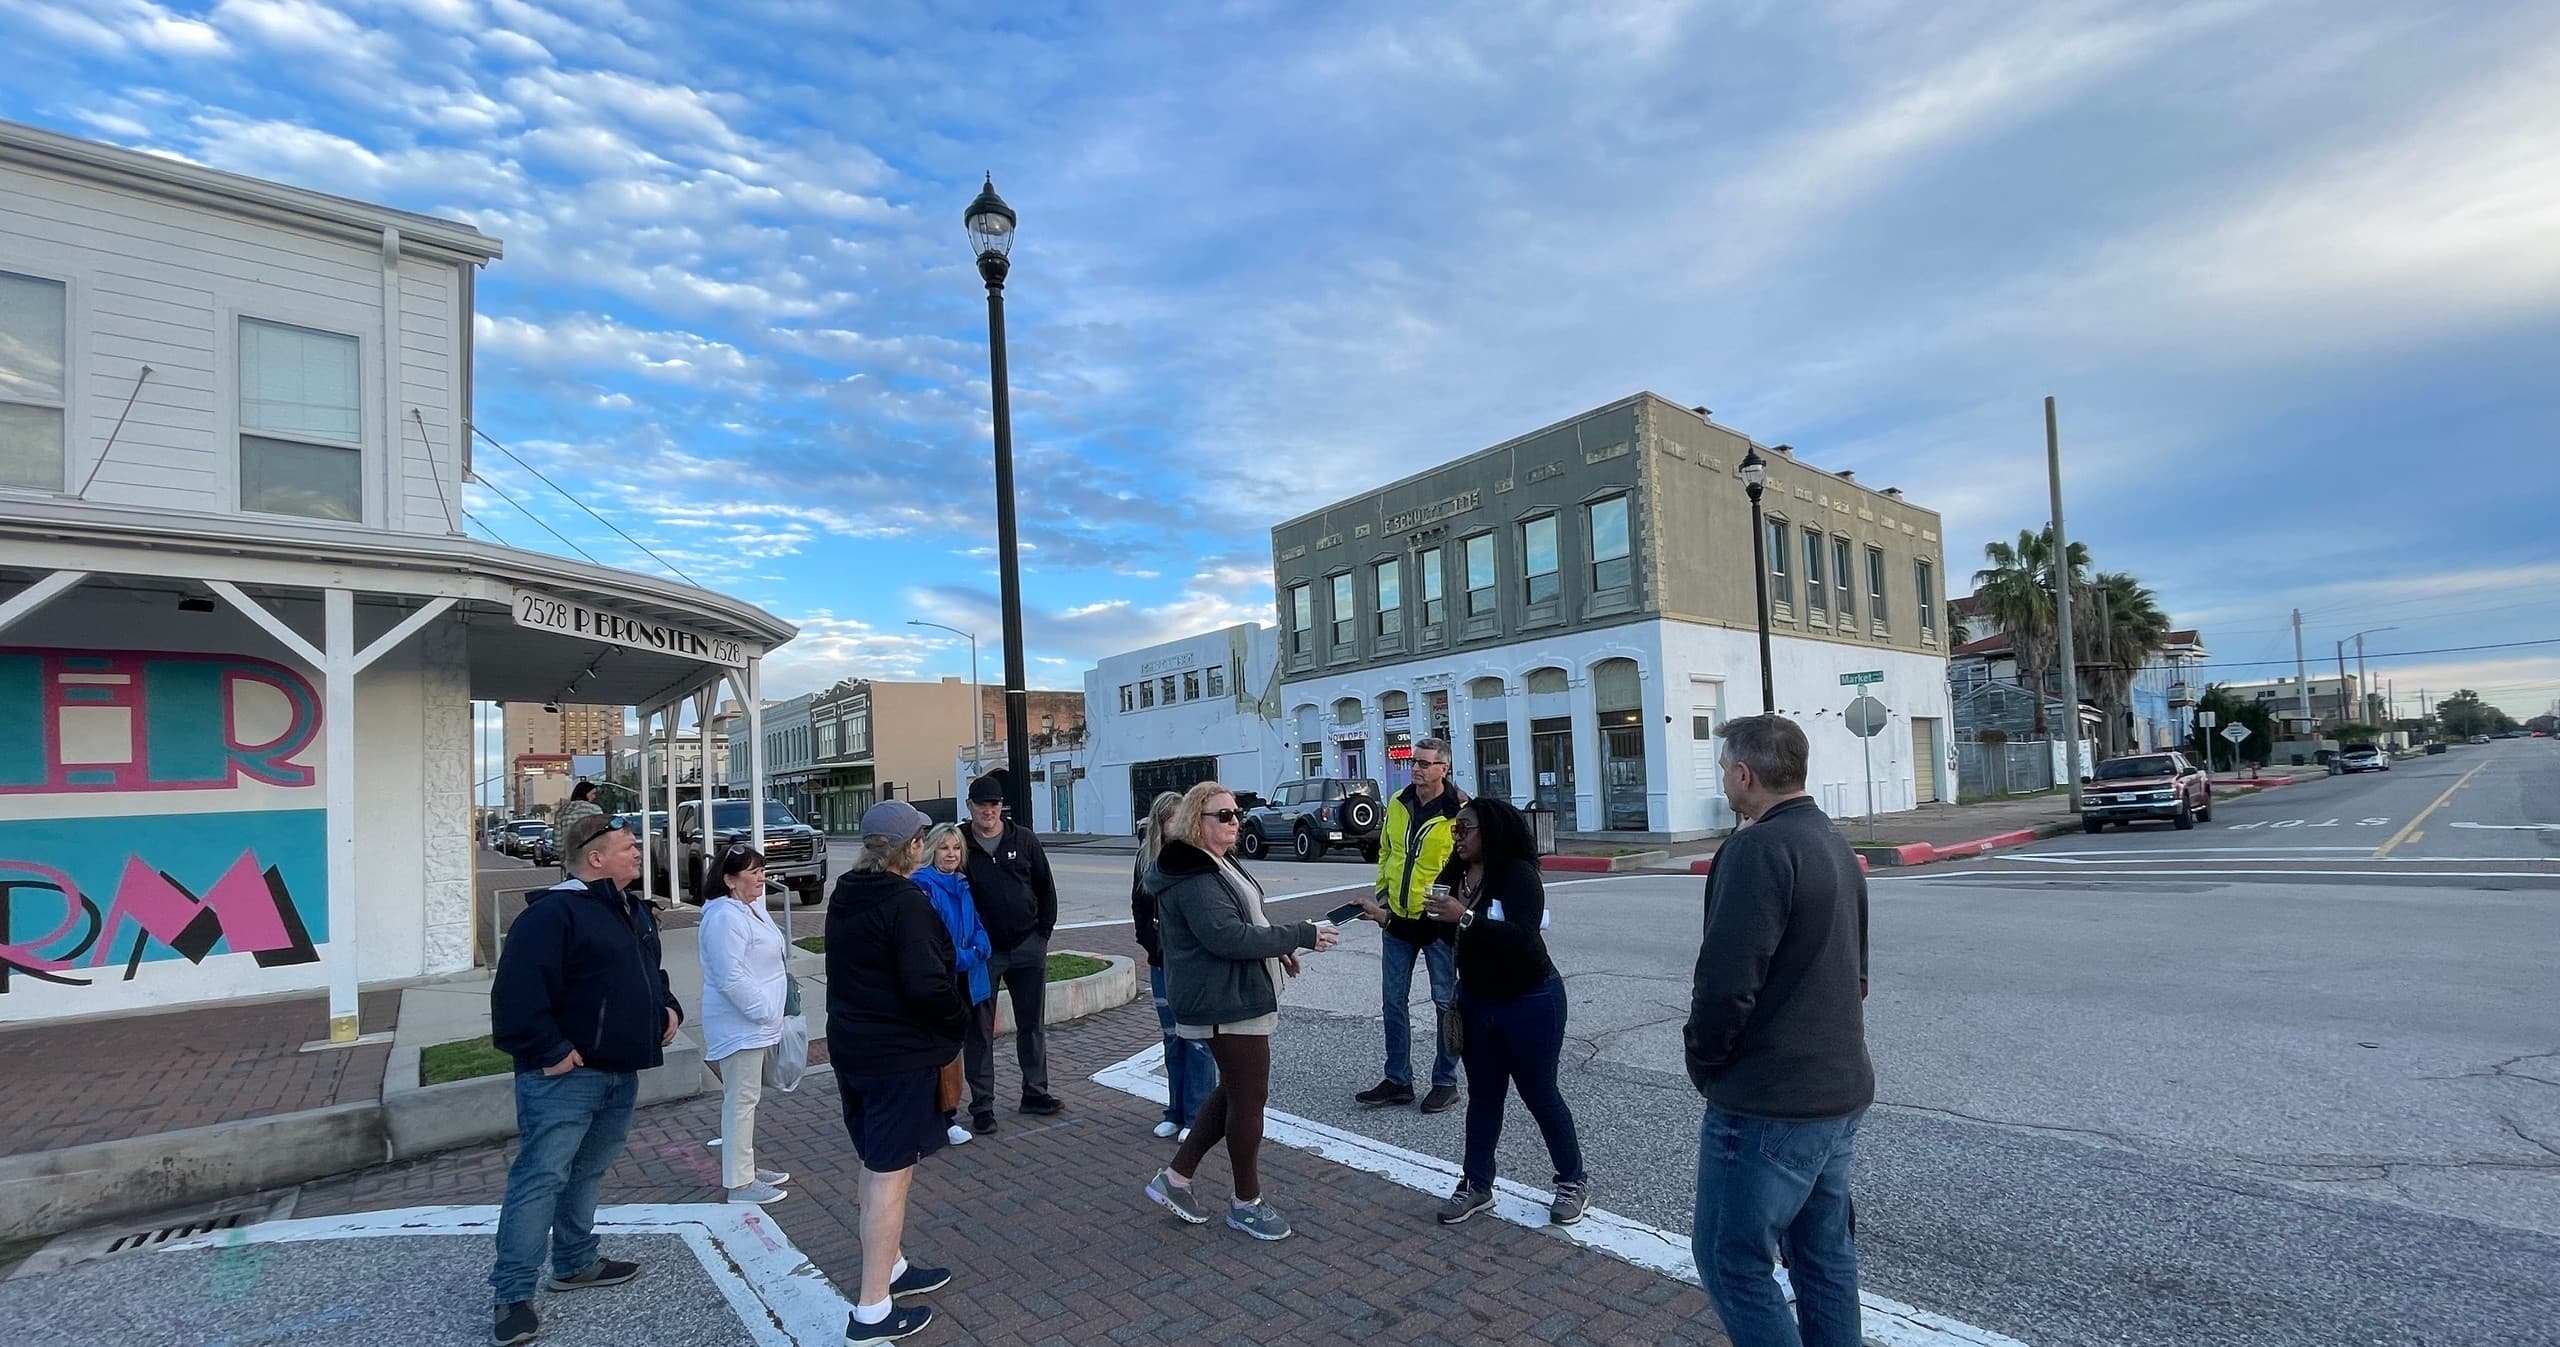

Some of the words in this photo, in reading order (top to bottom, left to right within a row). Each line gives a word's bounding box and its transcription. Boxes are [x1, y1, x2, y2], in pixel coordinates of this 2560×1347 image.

[522, 595, 567, 628] 2528
[574, 607, 590, 633] P.
[595, 612, 709, 656] BRONSTEIN
[712, 638, 741, 663] 2528
[1841, 673, 1872, 684] Market
[1328, 732, 1345, 742] NOW
[1348, 730, 1368, 740] OPEN
[2226, 816, 2391, 830] STOP
